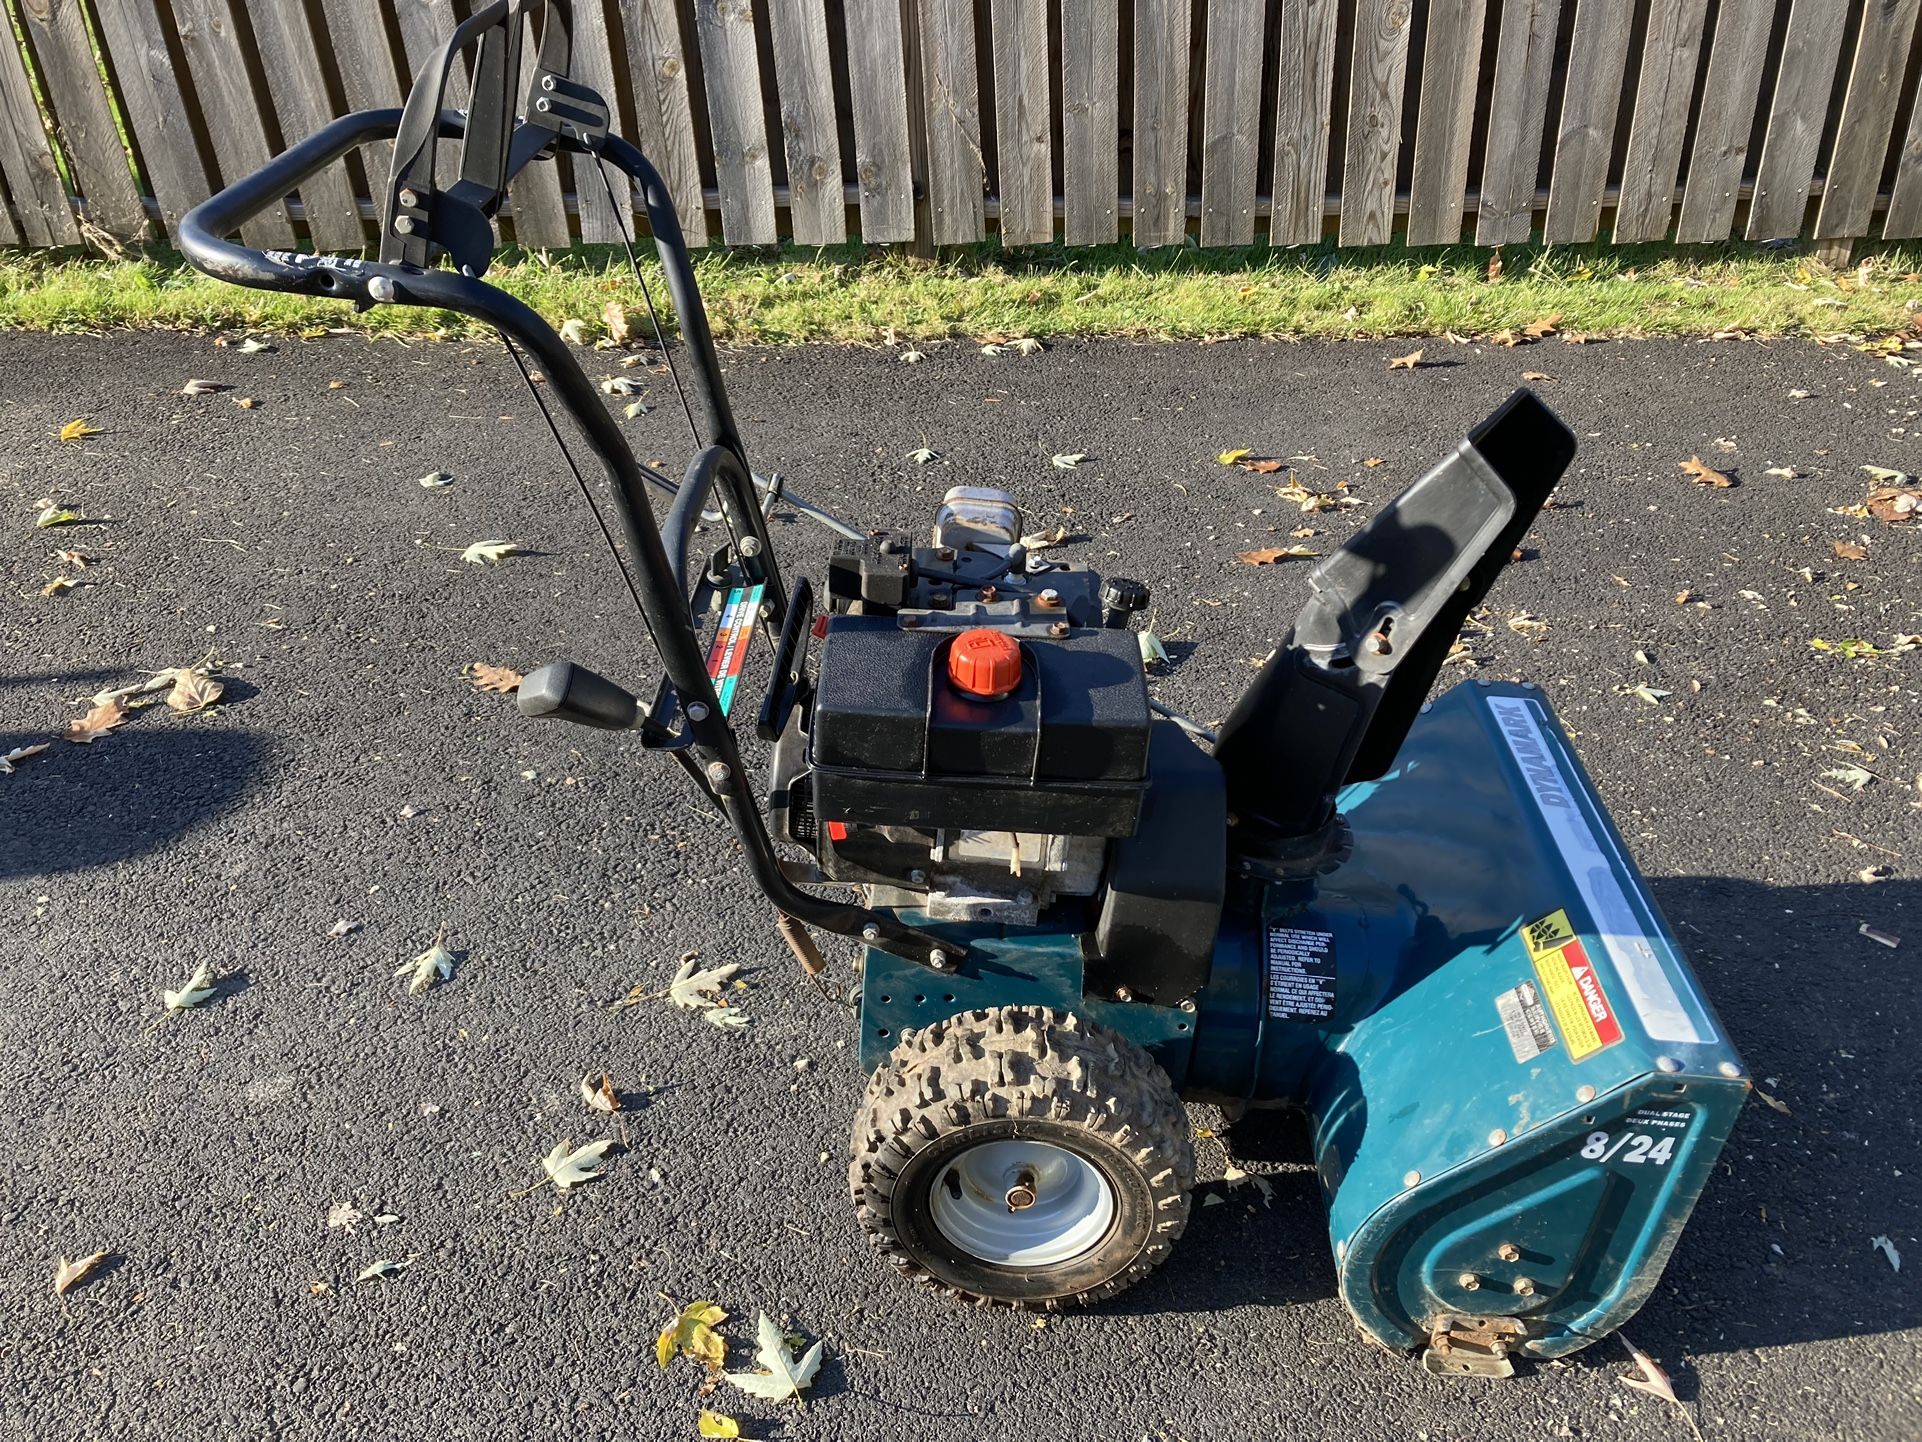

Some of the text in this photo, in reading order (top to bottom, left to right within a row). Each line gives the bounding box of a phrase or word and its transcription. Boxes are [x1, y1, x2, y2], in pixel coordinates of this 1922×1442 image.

[727, 618, 742, 644] CONTROL
[1495, 703, 1571, 808] DYNAMARK
[1277, 948, 1310, 957] PERIODICALLY
[1579, 975, 1608, 1023] DANGER
[1625, 1117, 1686, 1128] DEUX PHASES
[1637, 1109, 1691, 1119] DUAL STAGE
[1580, 1131, 1676, 1165] 8/24
